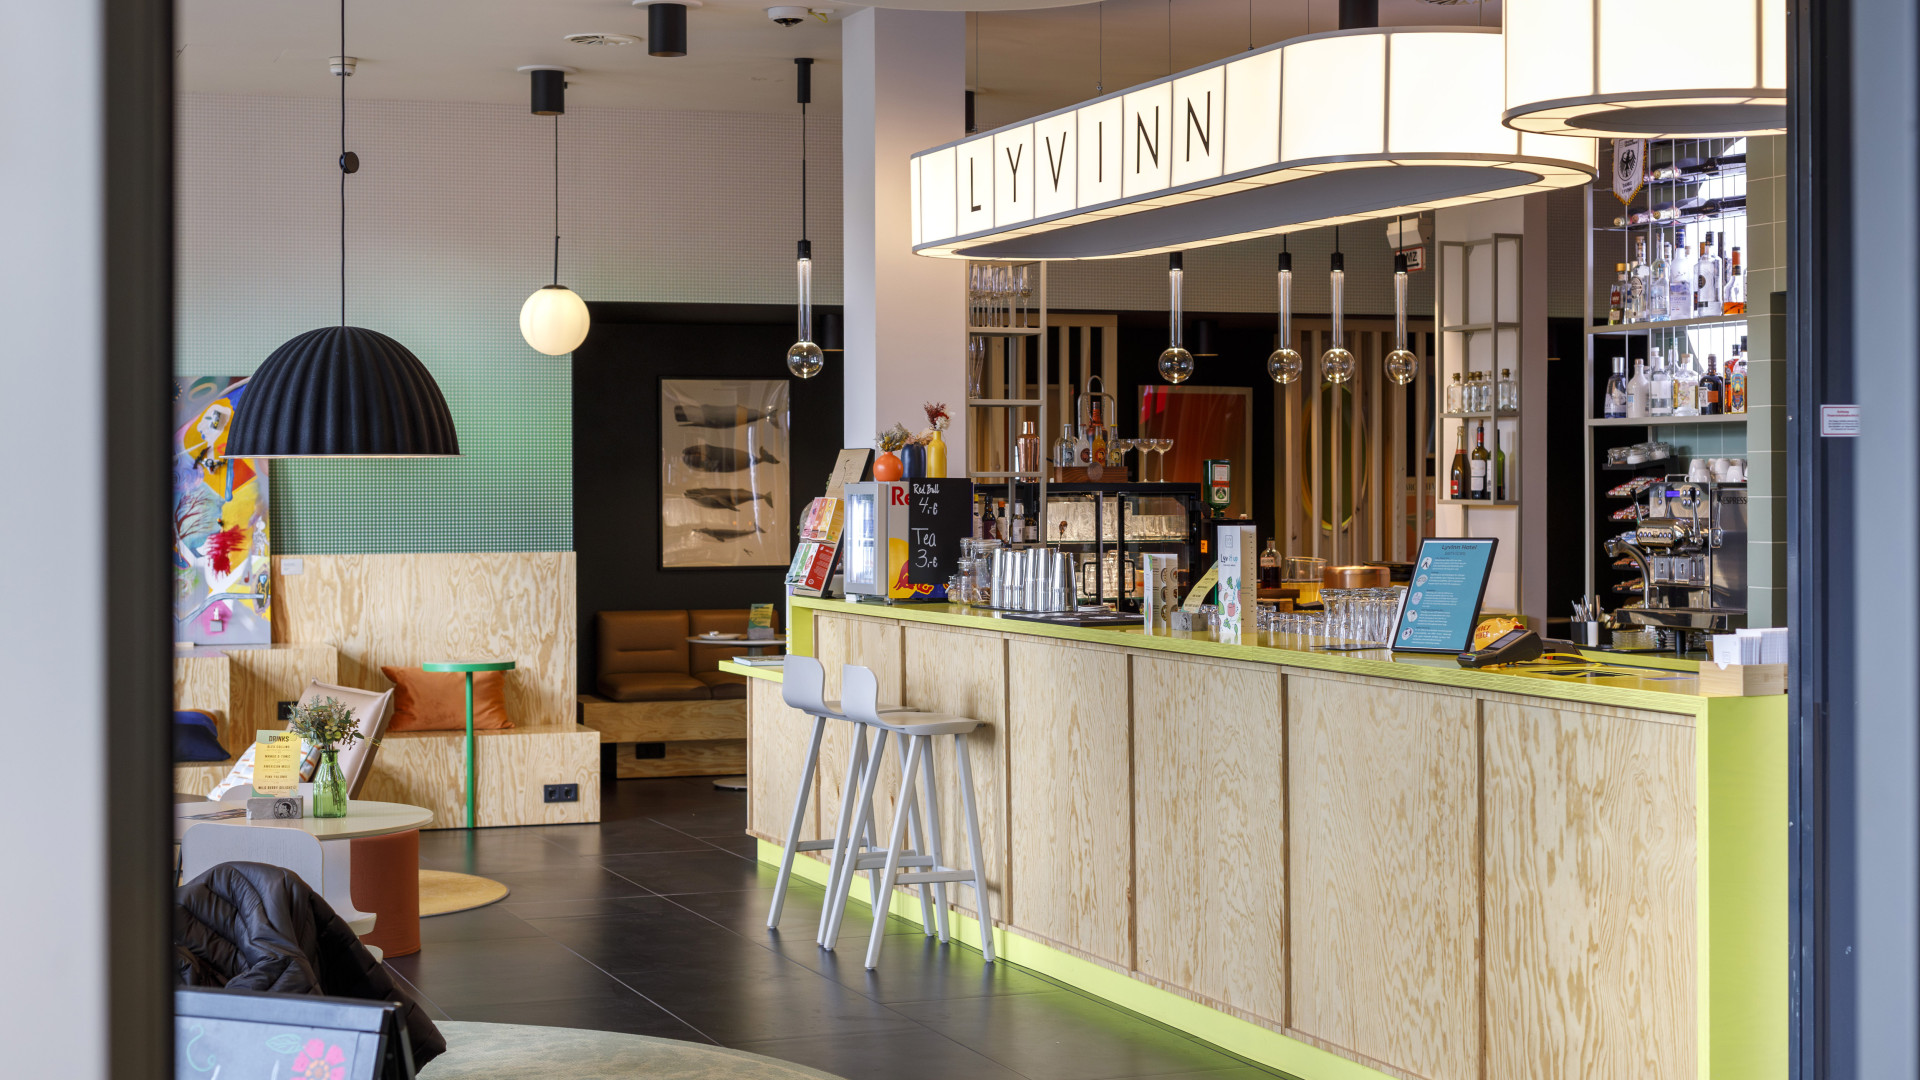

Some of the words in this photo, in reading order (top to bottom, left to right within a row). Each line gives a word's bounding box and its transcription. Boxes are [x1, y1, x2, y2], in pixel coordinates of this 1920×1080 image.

[970, 90, 1211, 212] LYVINN
[1406, 251, 1417, 263] MZ
[891, 486, 910, 506] Re
[913, 483, 926, 494] Red
[926, 483, 940, 495] Bull
[1722, 496, 1747, 505] ESPRESS
[911, 527, 937, 547] Tea
